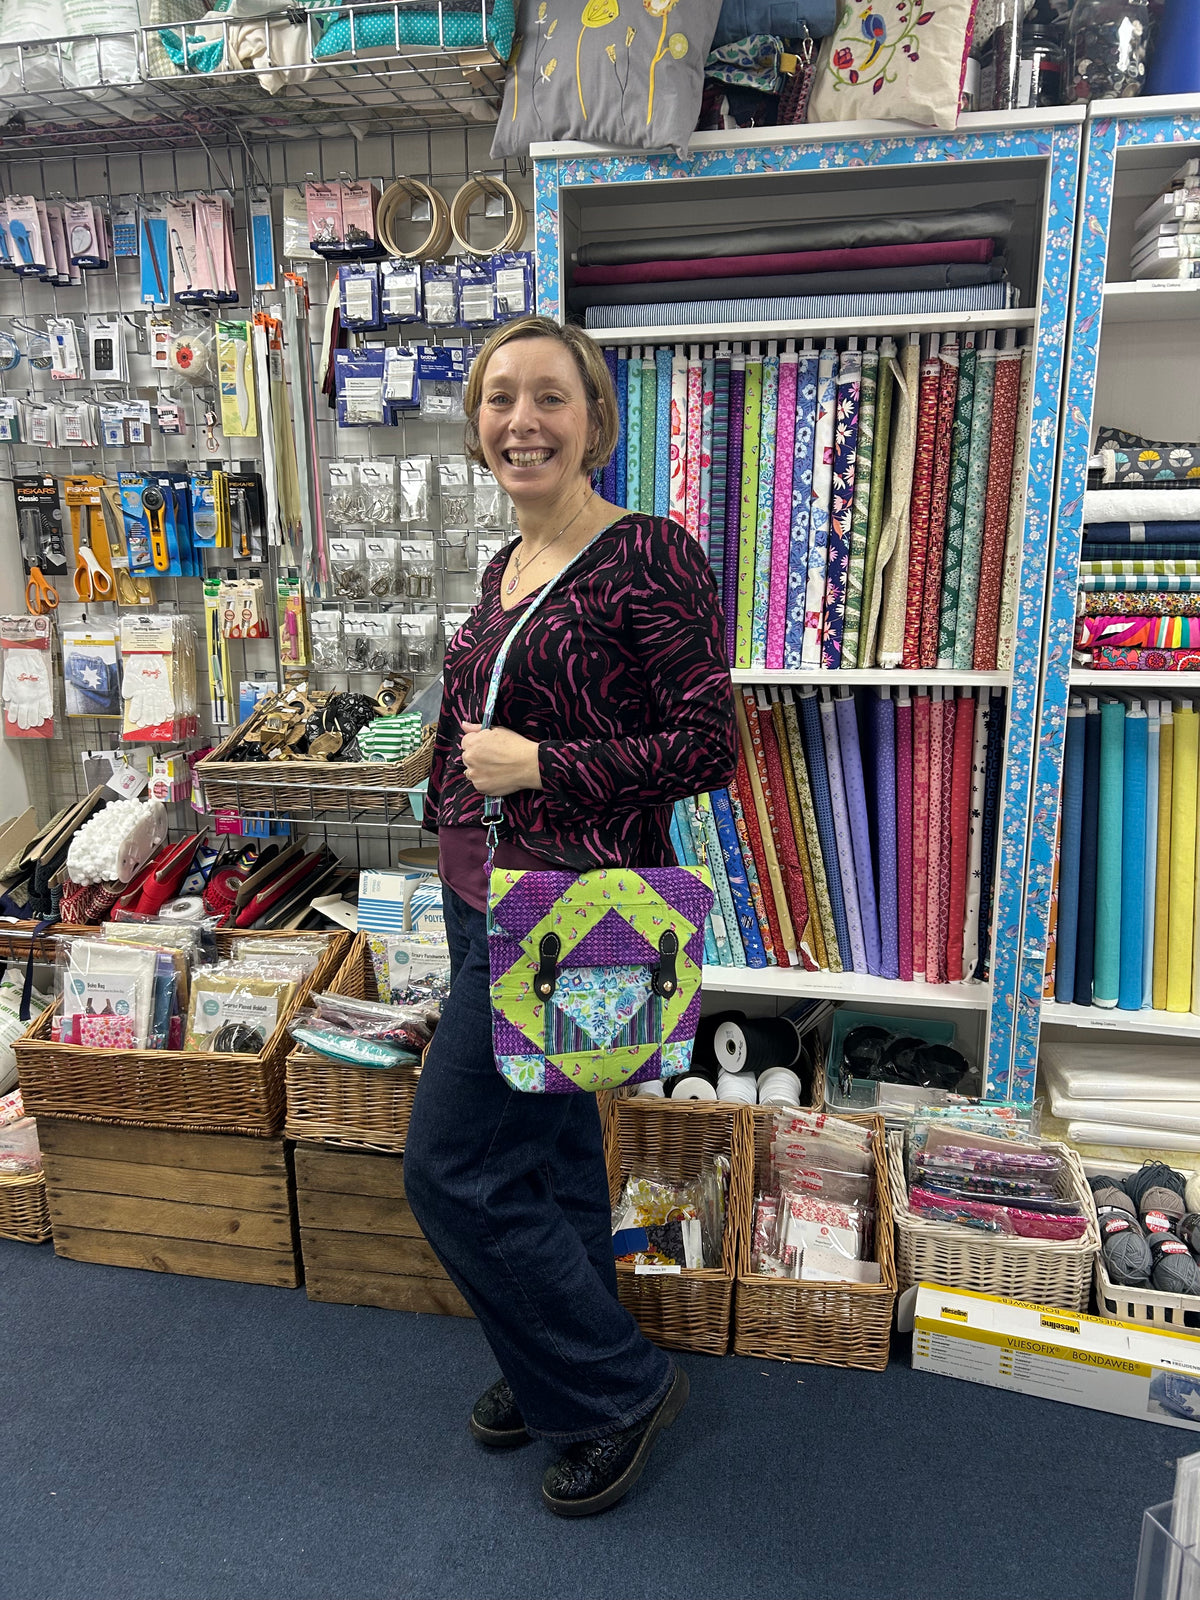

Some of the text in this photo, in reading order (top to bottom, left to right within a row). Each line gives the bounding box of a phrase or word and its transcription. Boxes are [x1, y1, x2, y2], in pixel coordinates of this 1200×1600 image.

[121, 478, 143, 486] OLFA
[17, 487, 57, 495] FISKARS
[807, 1171, 820, 1179] Sale
[804, 1181, 820, 1189] Price
[1151, 1211, 1165, 1219] Sale
[1149, 1223, 1166, 1232] Price
[941, 1306, 968, 1317] vlieseline
[1041, 1318, 1080, 1333] vlieseline
[1007, 1337, 1060, 1355] VLIESOFIX®
[1072, 1350, 1140, 1371] BONDAWEB®
